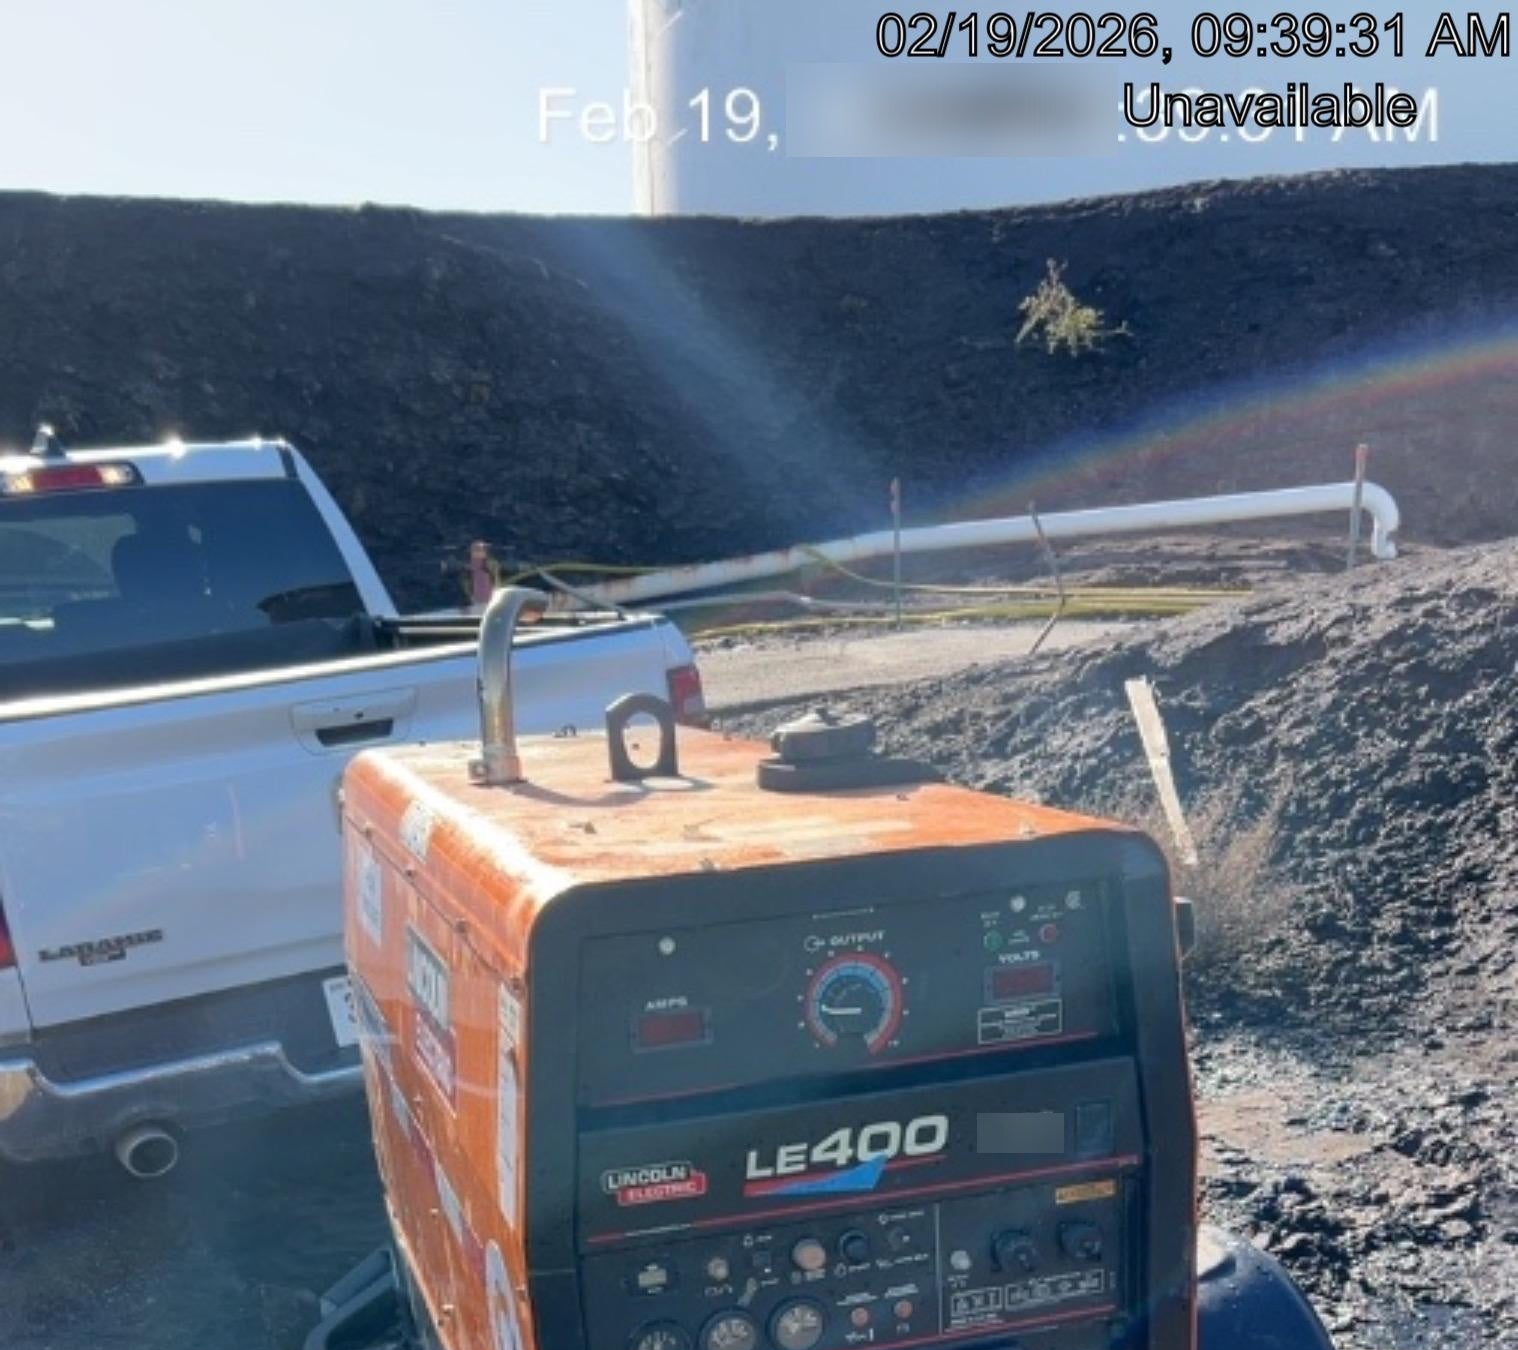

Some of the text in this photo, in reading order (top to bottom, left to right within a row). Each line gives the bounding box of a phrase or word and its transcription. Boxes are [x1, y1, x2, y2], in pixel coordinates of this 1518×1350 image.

[830, 929, 886, 946] OUTPUT
[746, 1115, 949, 1180] LE400
[607, 1165, 687, 1190] LINCOLN
[628, 1179, 698, 1202] ELECTRIC
